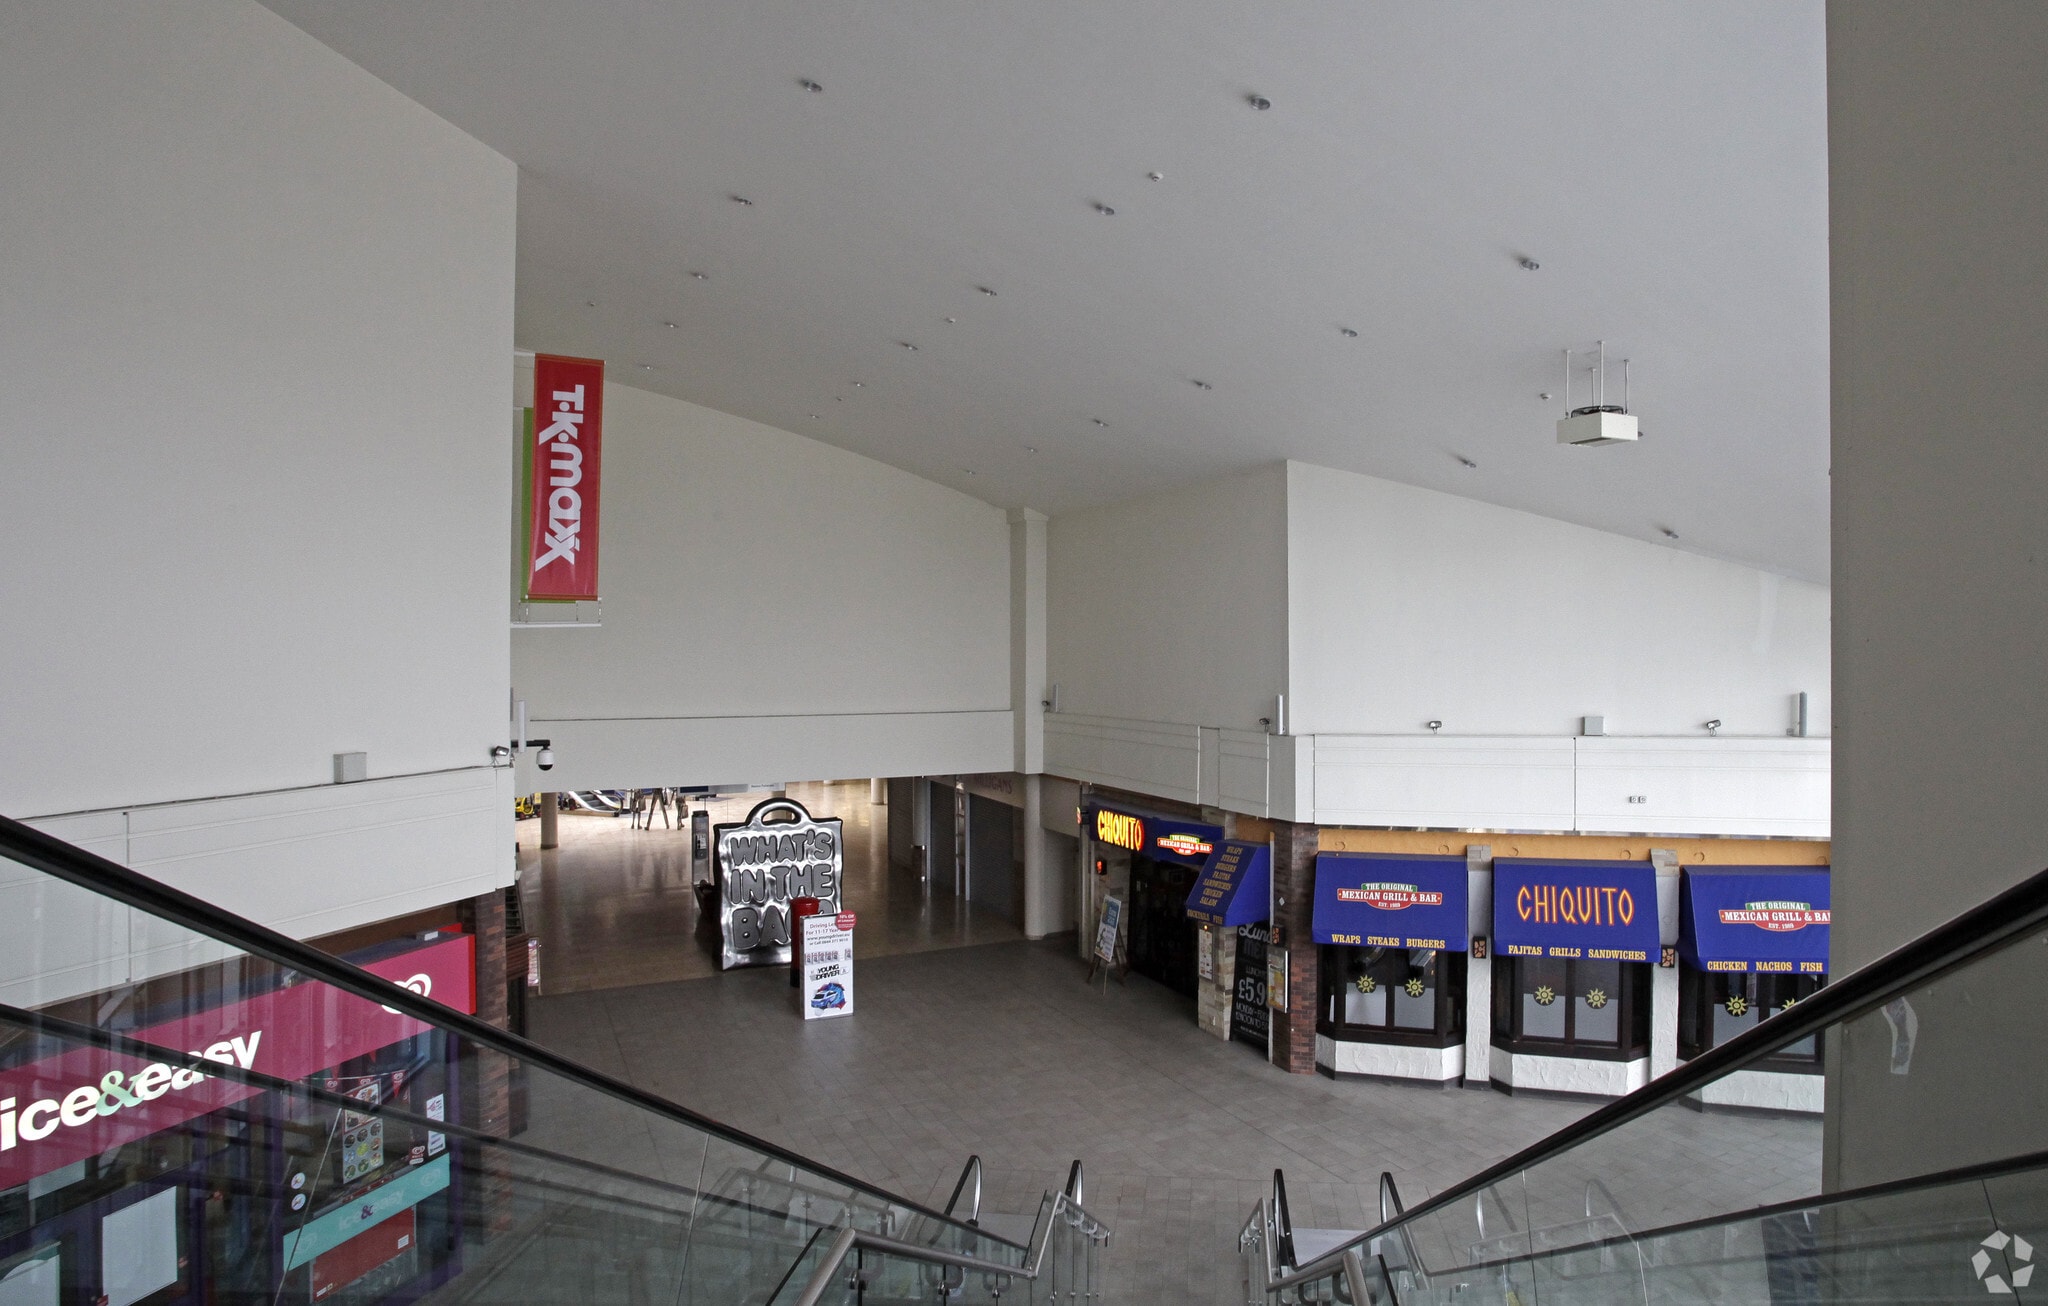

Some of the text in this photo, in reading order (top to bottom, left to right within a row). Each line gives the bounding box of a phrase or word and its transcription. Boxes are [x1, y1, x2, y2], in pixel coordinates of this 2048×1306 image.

[1097, 810, 1144, 852] CHIQUITO
[730, 829, 832, 866] WHAT'S
[1181, 842, 1195, 850] GRILL
[1200, 843, 1210, 852] BAR
[731, 863, 834, 904] IN THE
[1381, 883, 1413, 892] ORIGINAL
[1342, 891, 1437, 902] MEXICAN GRILL & BAR
[1517, 885, 1635, 926] CHIQUITO
[1750, 902, 1806, 910] THE ORIGINAL
[1724, 912, 1769, 920] MEXICAN
[1772, 912, 1801, 922] GRILL
[1804, 912, 1812, 922] &
[1332, 934, 1445, 948] WRAPS STEAKS BURGERS
[1508, 945, 1646, 960] FAJITAS GRILLS SANDWICHES
[818, 964, 839, 974] YOUNG
[1707, 961, 1823, 972] CHICKEN NACHOS FISH
[815, 970, 840, 980] DRIVER
